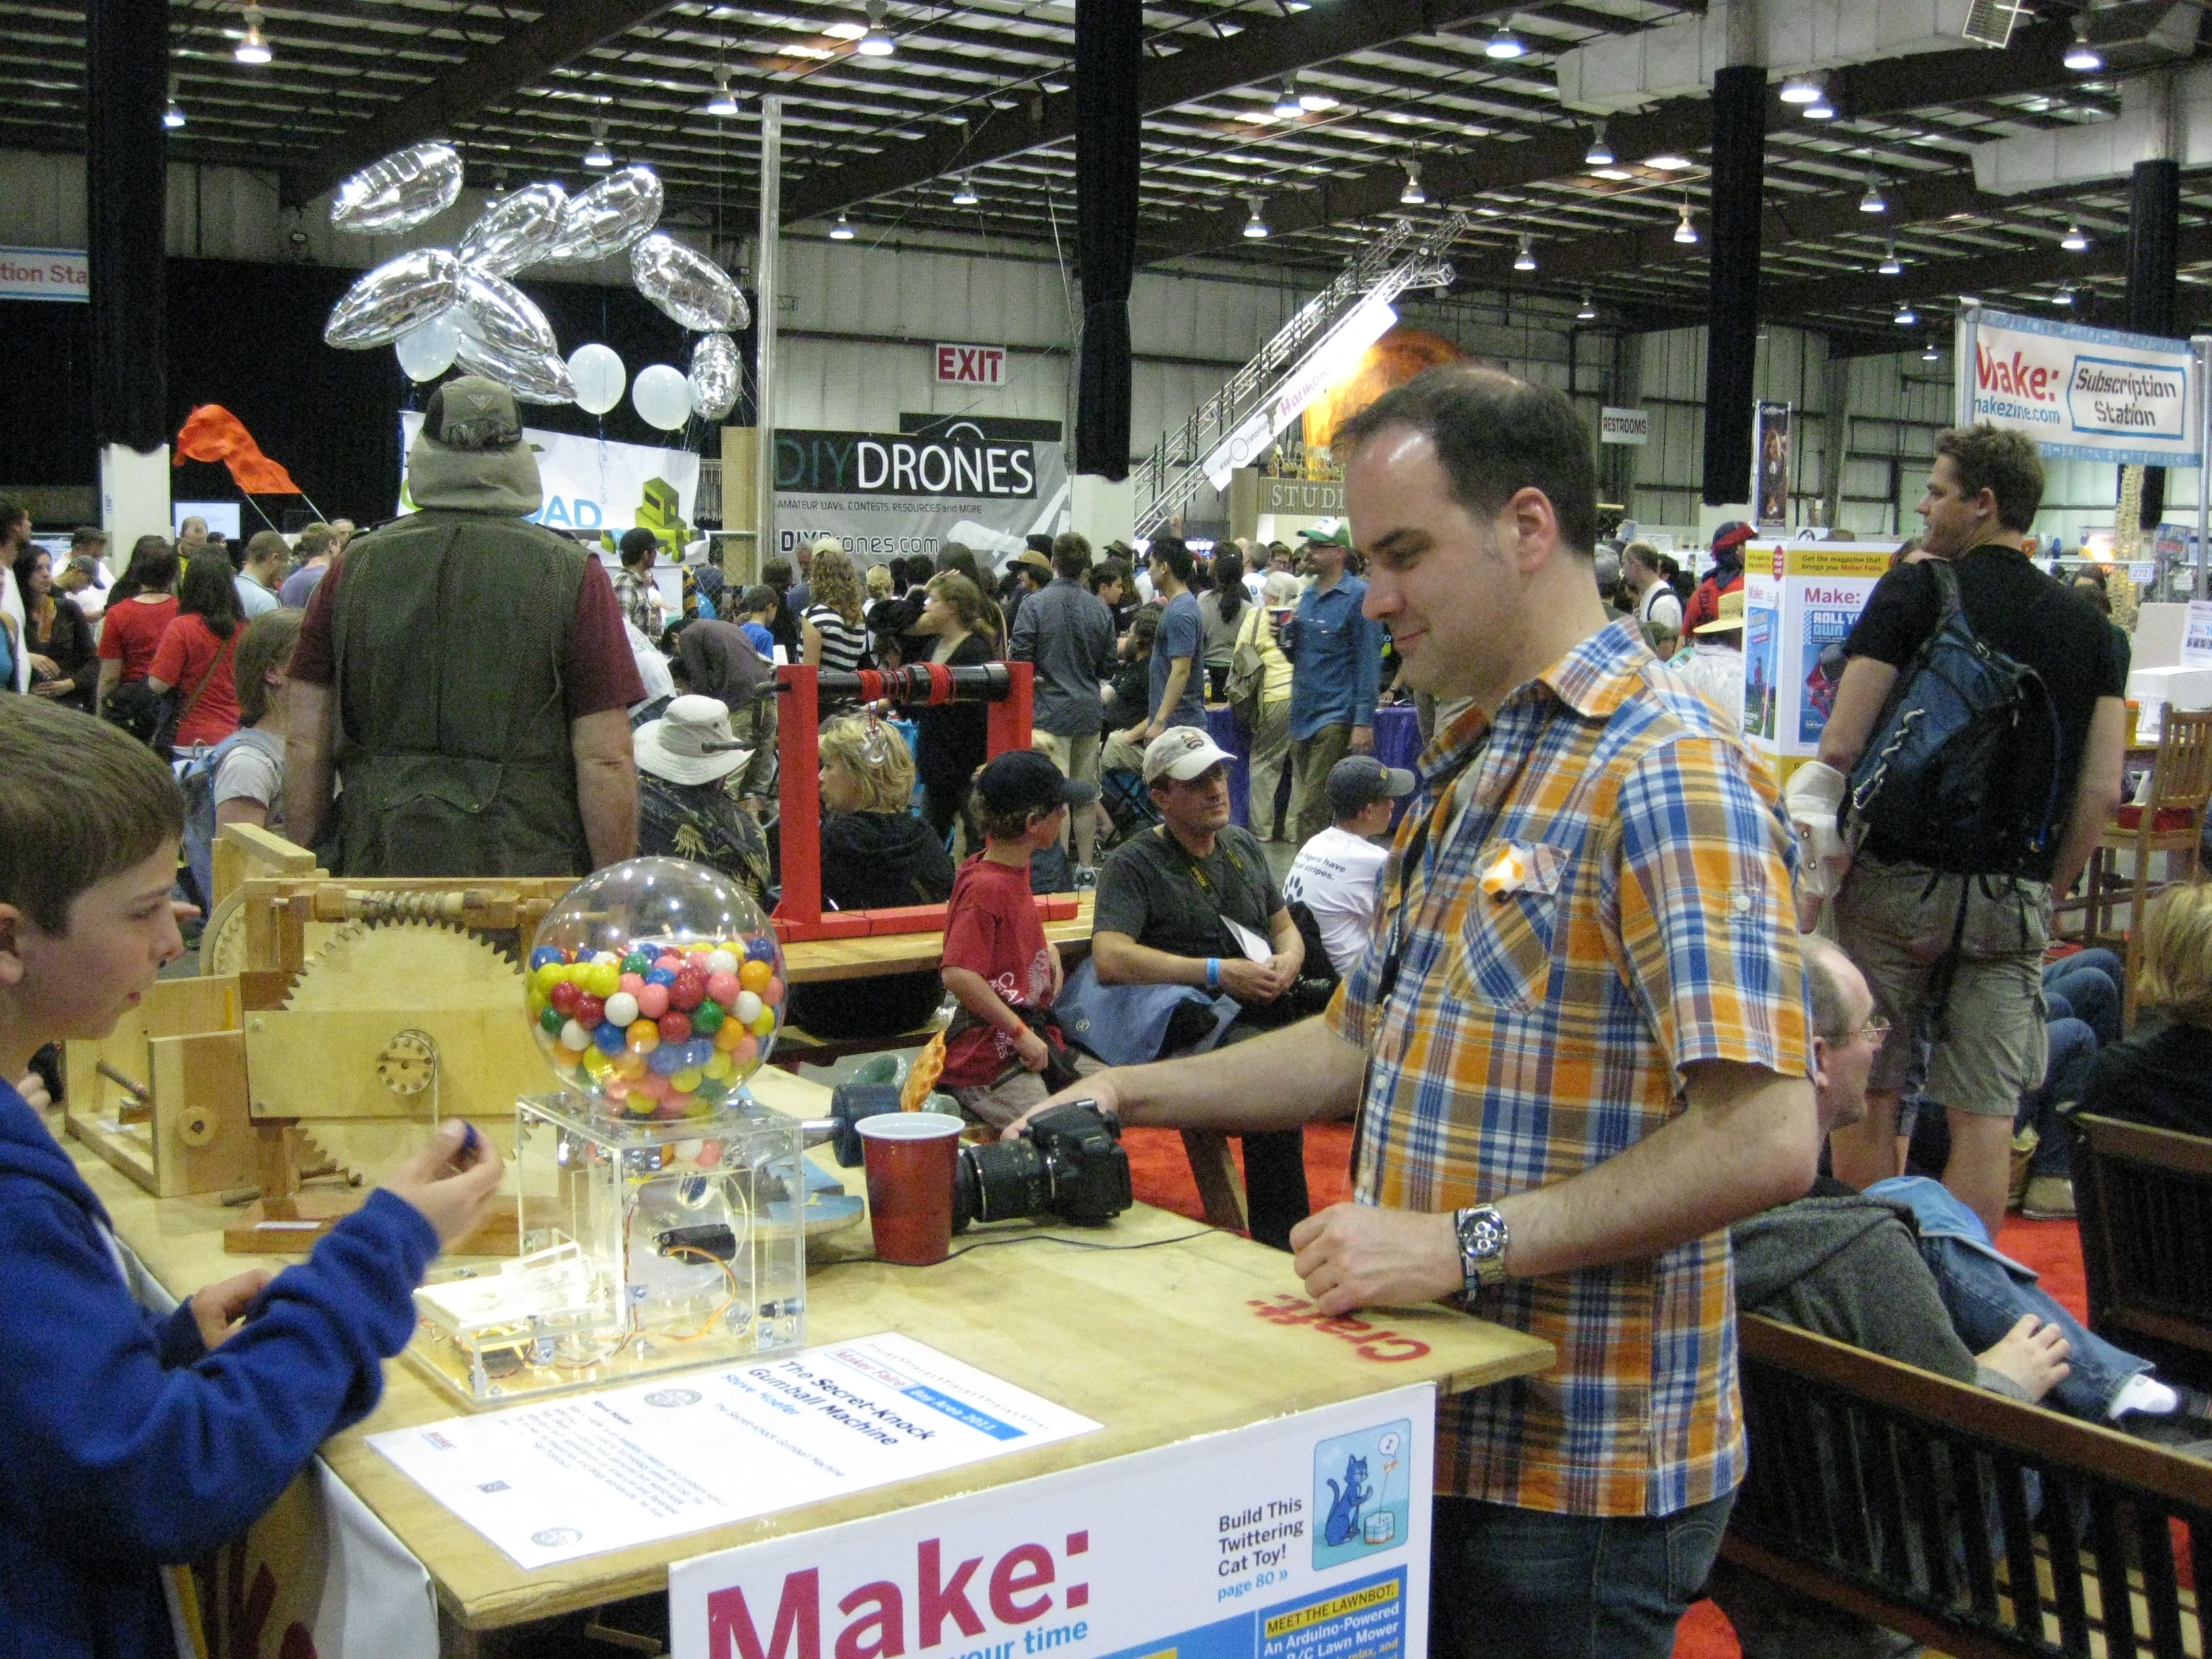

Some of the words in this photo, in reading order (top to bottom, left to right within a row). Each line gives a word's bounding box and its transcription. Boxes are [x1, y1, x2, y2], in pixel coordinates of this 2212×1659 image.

[938, 347, 1003, 382] EXIT
[2075, 367, 2177, 401] Subscription
[1603, 416, 1647, 434] RESTROOMS
[2094, 401, 2156, 426] Station
[520, 495, 602, 529] AD
[778, 499, 818, 510] AMATEUR
[893, 502, 940, 513] RESOURCES
[943, 504, 957, 513] and
[959, 505, 982, 514] MORE
[1271, 485, 1345, 509] STUDI
[2132, 569, 2148, 578] 272
[1805, 587, 1860, 604] Make:
[1323, 859, 1346, 873] have
[749, 1368, 826, 1405] Gumball
[818, 1405, 898, 1445] Machine
[780, 1361, 814, 1378] The
[811, 1378, 934, 1439] Secret-Knock
[1219, 1506, 1262, 1532] Build
[1267, 1497, 1302, 1518] This
[1219, 1520, 1303, 1554] Twittering
[1218, 1555, 1248, 1576] Cat
[1253, 1543, 1286, 1567] Toy!
[708, 1529, 1088, 1659] Make:
[1218, 1580, 1252, 1602] page
[1256, 1571, 1275, 1588] 80
[1264, 1641, 1282, 1658] An
[1286, 1601, 1399, 1650] Arduino-Powered
[1267, 1613, 1301, 1634] MEET
[1307, 1605, 1328, 1622] THE
[1023, 1620, 1088, 1654] time
[1318, 1636, 1352, 1656] Lawn
[1356, 1621, 1400, 1645] Mower
